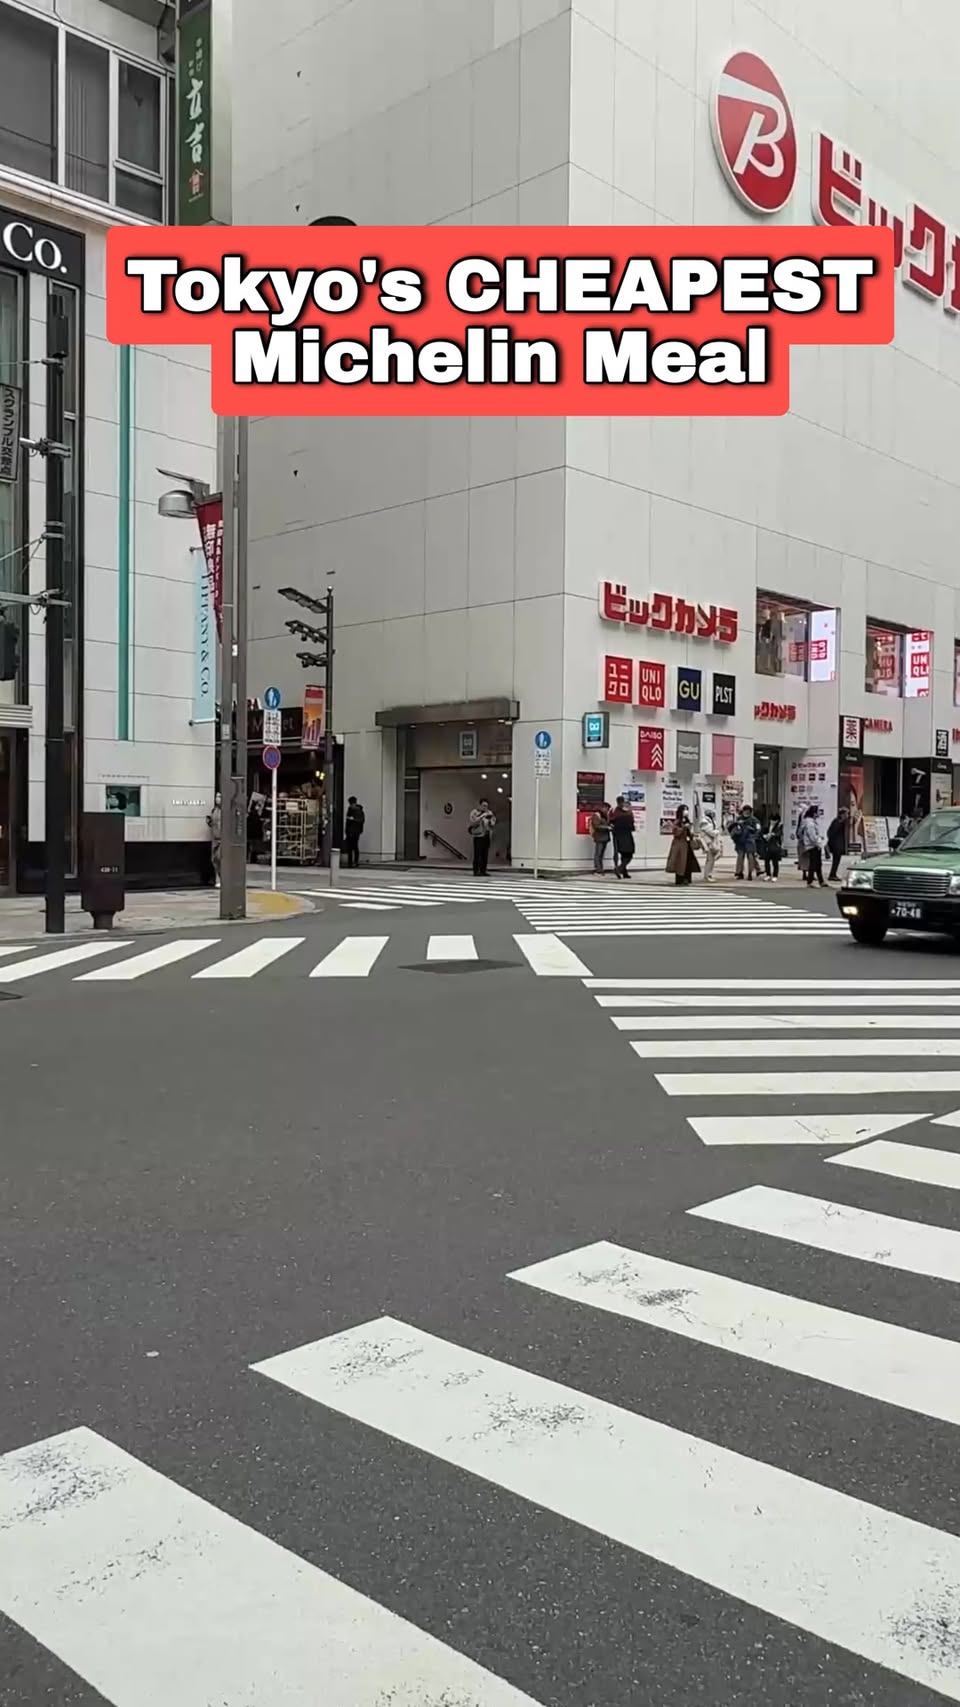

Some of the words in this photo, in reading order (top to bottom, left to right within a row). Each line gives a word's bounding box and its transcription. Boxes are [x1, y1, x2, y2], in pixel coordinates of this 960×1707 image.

[601, 581, 739, 643] ビックカメラ
[608, 663, 629, 680] ユニ
[641, 667, 661, 684] UNI
[608, 680, 629, 697] クロ
[641, 685, 662, 702] QLO
[678, 680, 700, 700] GU
[715, 686, 734, 704] PLST
[640, 730, 663, 741] DAISO
